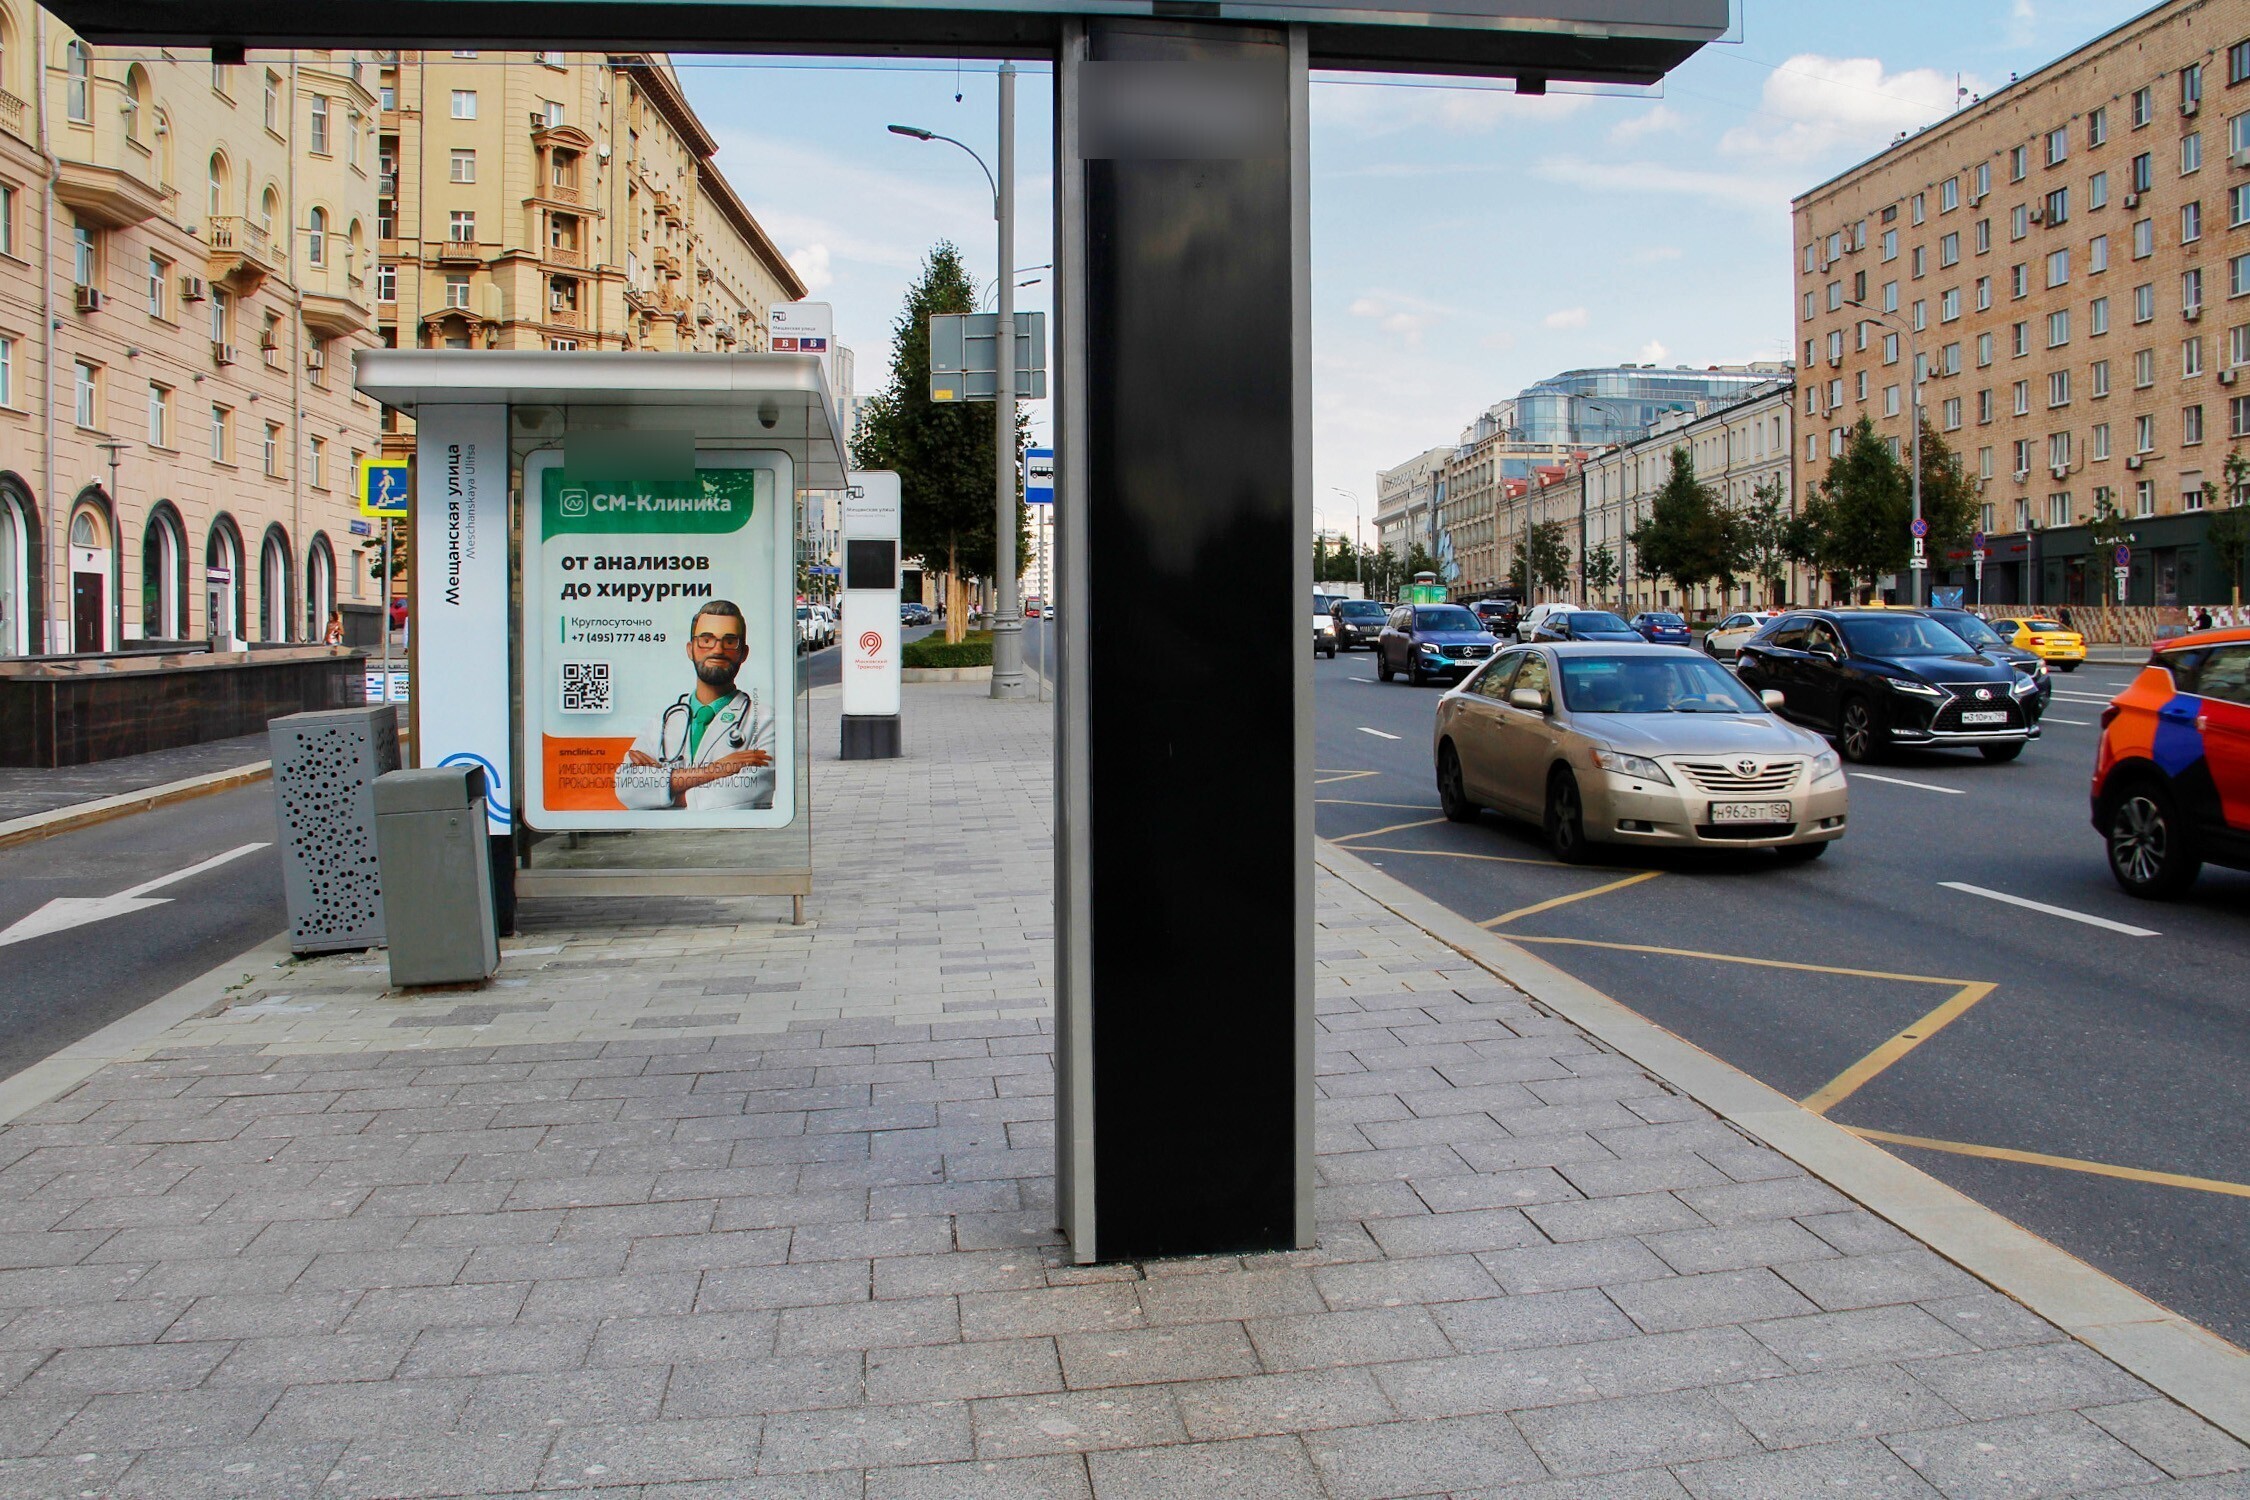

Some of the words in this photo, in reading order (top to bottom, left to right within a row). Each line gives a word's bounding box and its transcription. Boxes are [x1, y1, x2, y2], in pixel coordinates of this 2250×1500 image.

[465, 444, 476, 475] Ulitsa
[448, 443, 463, 496] улица
[592, 493, 732, 512] СМ-Клиника
[465, 478, 477, 560] Meschanskaya
[445, 501, 462, 606] Мещанская
[561, 556, 589, 571] от
[594, 555, 710, 571] анализов
[561, 582, 591, 601] до
[597, 582, 712, 602] хирургии
[571, 617, 652, 628] Круглосуточно
[572, 633, 585, 643] +7
[587, 632, 614, 643] (495)
[616, 633, 636, 643] 777
[638, 633, 652, 643] 48
[653, 633, 667, 643] 49
[559, 749, 606, 757] smclinic.ru
[558, 763, 602, 775] ИМЕЮТСЯ
[697, 762, 758, 775] НЕОБХОДИМО
[558, 776, 670, 789] ПРОКОНСУЛЬТИРОВАТЬСЯ
[671, 776, 683, 789] СО
[684, 776, 758, 789] СПЕЦИАЛИСТОМ
[1716, 805, 1765, 819] Н962ВТ
[1770, 804, 1787, 815] 150
